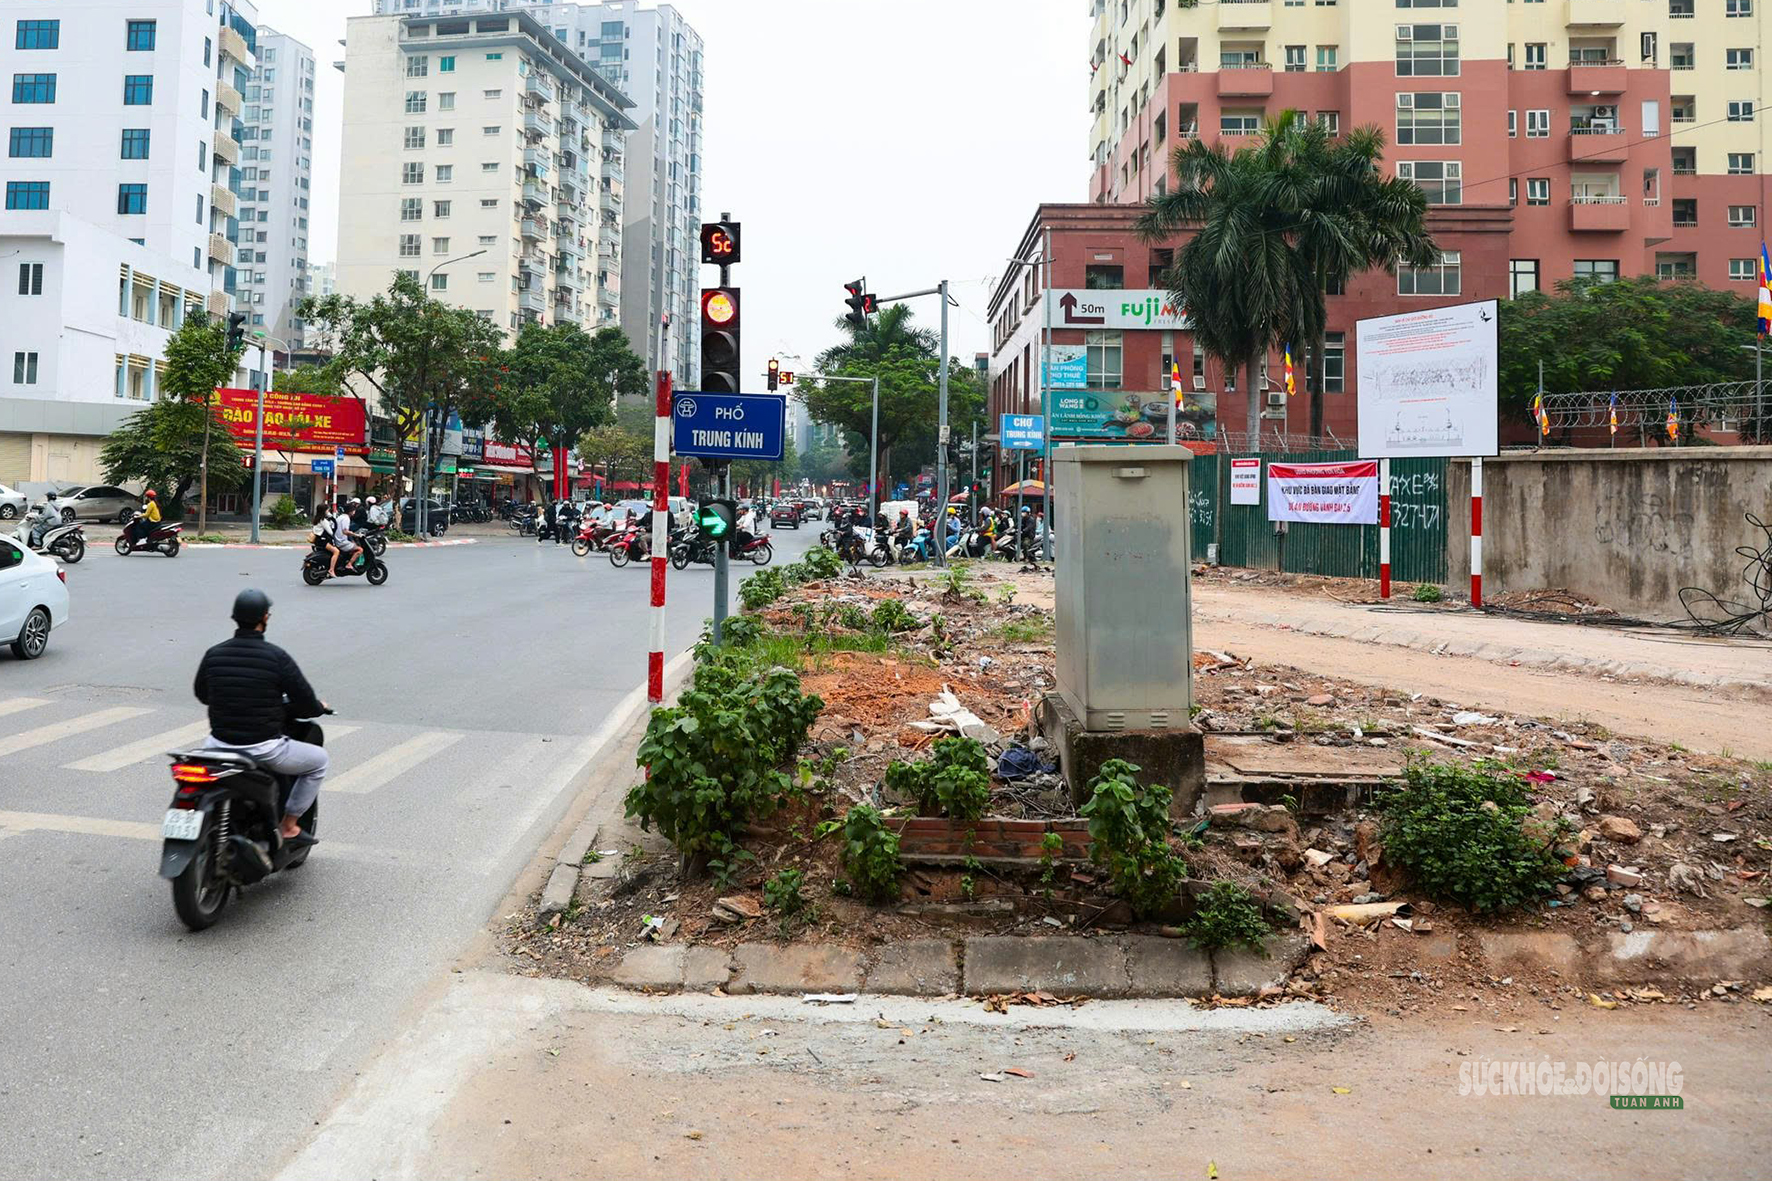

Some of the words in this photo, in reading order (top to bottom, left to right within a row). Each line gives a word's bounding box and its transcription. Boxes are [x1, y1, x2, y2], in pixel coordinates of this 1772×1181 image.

[1081, 304, 1105, 314] 50m
[269, 392, 289, 401] CÔNG
[715, 402, 744, 420] PHỐ
[314, 414, 332, 428] XE
[1013, 417, 1034, 429] CHỢ
[692, 429, 731, 448] TRUNG
[734, 428, 764, 449] KÍNH
[1005, 430, 1026, 439] TRUNG
[1026, 429, 1042, 439] KÍNH
